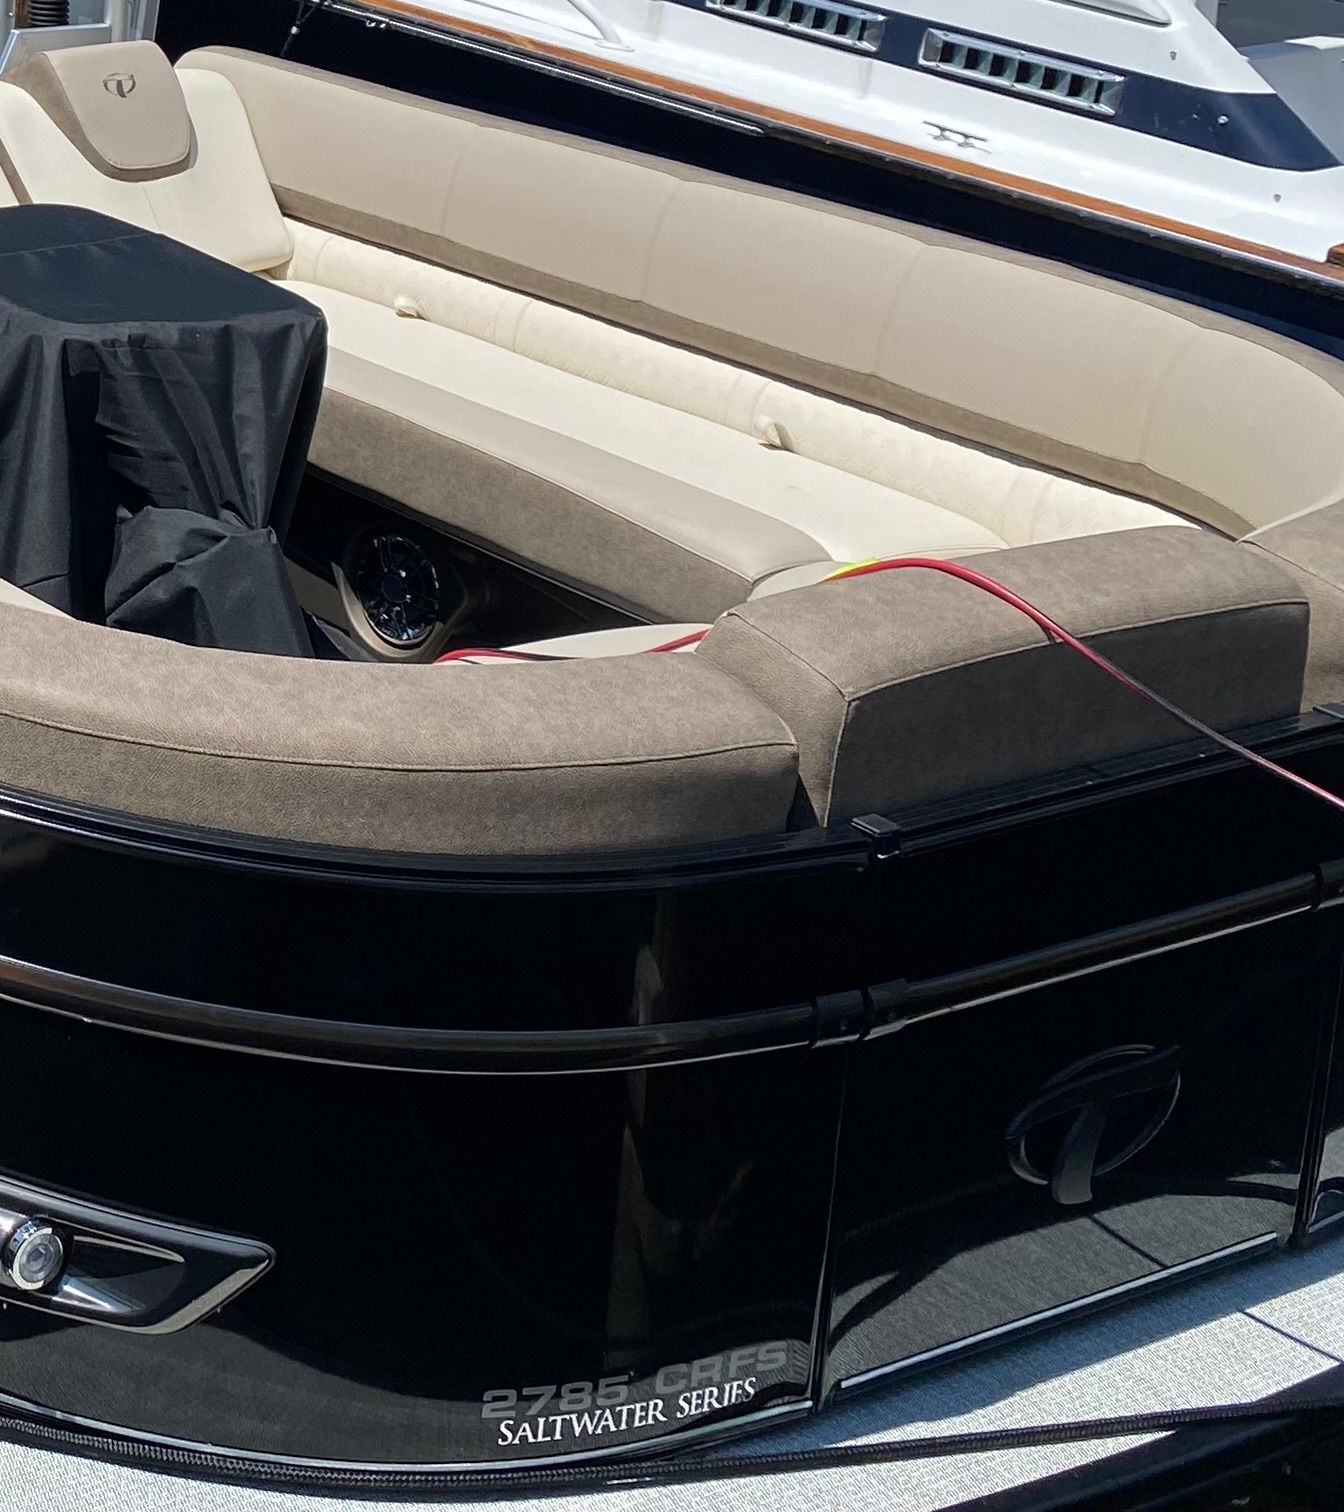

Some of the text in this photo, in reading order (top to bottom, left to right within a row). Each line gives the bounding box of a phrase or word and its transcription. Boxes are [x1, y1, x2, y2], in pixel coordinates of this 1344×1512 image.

[481, 1340, 788, 1419] 2785 CRFS
[497, 1376, 757, 1446] SALTWATER SERIES
